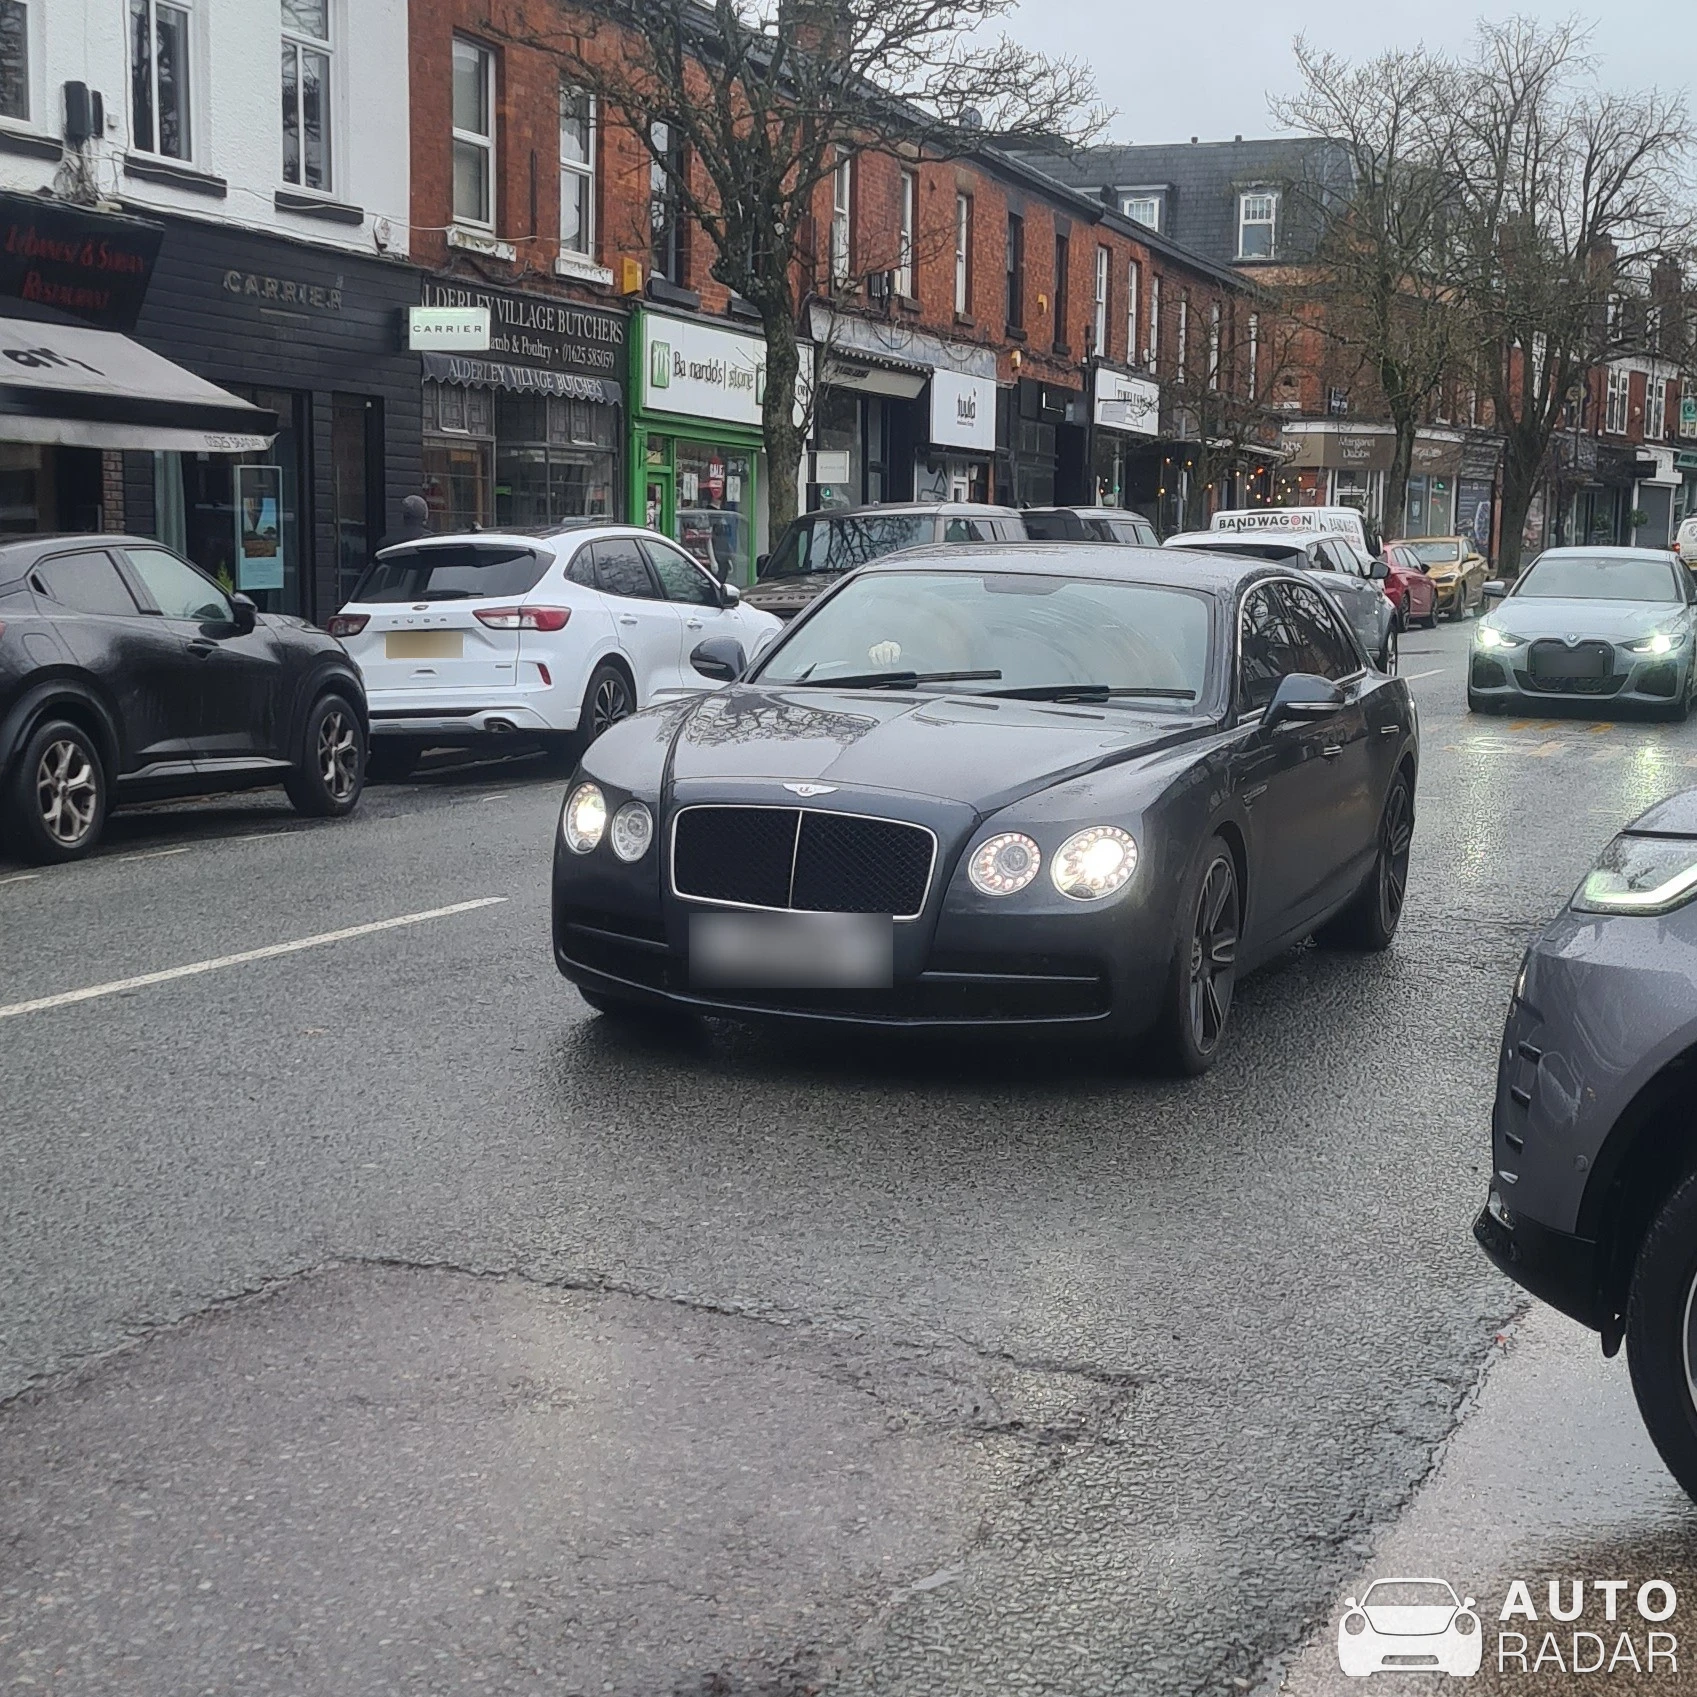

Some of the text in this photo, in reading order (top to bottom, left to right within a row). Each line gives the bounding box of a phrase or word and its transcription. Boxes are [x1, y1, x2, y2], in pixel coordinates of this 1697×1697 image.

[223, 270, 341, 310] CARRIER
[413, 325, 482, 333] CARRIER
[497, 298, 554, 332] VILLAGE
[558, 311, 624, 345] BUTCHERS
[490, 333, 510, 351] amb
[512, 335, 520, 354] &
[521, 335, 552, 365] Poultry
[448, 358, 505, 383] ALDERLEY
[1219, 515, 1312, 530] BANDWAGON
